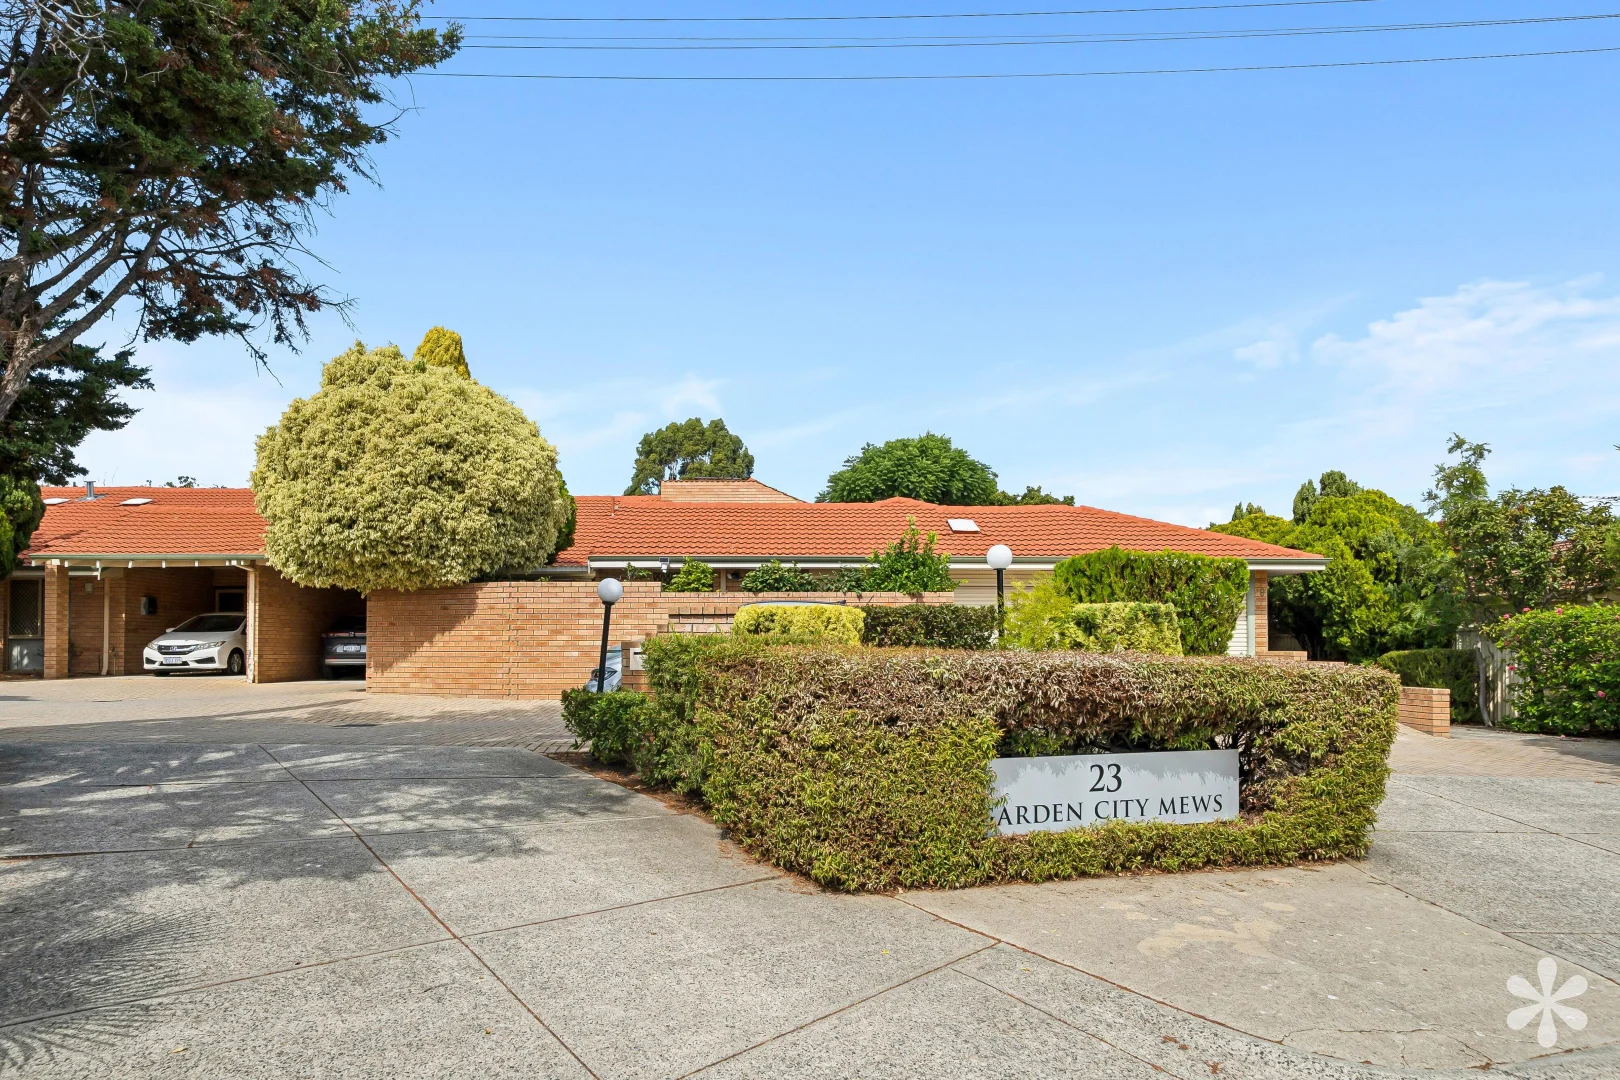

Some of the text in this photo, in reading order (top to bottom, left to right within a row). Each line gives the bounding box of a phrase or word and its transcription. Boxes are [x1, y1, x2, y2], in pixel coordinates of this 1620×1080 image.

[1089, 763, 1122, 792] 23
[990, 794, 1223, 826] ARDEN CITY MEWS
